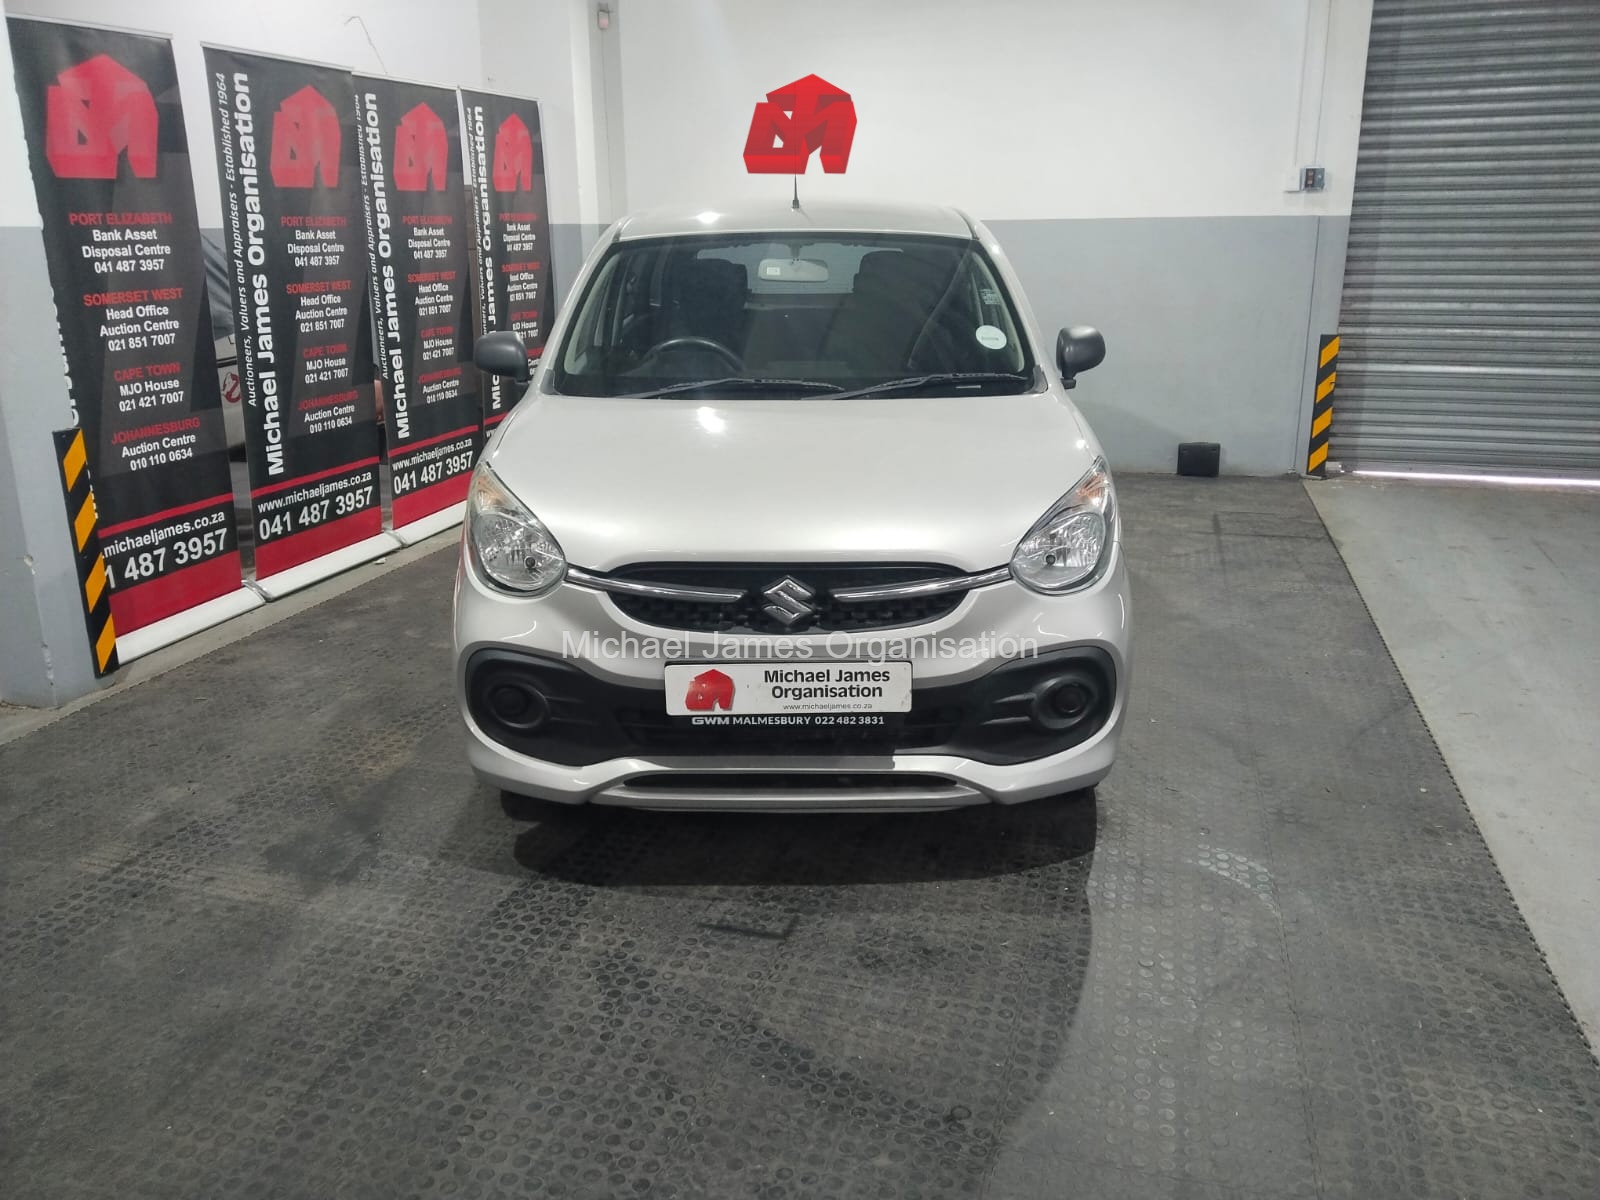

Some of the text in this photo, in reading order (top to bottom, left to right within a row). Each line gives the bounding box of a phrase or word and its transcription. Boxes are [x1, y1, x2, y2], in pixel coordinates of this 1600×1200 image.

[474, 106, 491, 251] Organisation
[69, 212, 172, 225] PORT ELIZABETH
[281, 216, 302, 226] PORT
[363, 195, 374, 250] Appraisers
[92, 228, 158, 242] Bank Asset
[216, 73, 256, 407] Auctioneers, Valuers and Appraisers Established 1964
[296, 230, 336, 240] Bank Asset
[414, 227, 444, 236] Bank Asset
[82, 244, 171, 260] Disposal Centre
[288, 242, 344, 255] Disposal Centre
[408, 239, 432, 248] Disposal
[94, 259, 164, 274] 041 487 3957
[294, 256, 340, 267] 041 487 3957
[365, 93, 410, 439] Michael James Organisation
[233, 72, 284, 476] Michael James Organisation
[286, 282, 329, 294] SOMERSET
[372, 276, 381, 314] Valuers
[432, 283, 448, 292] Office
[486, 257, 496, 325] James
[83, 288, 183, 306] SOMERSET WEST
[300, 294, 341, 306] Head Office
[414, 294, 453, 305] Auction Centre
[106, 305, 168, 320] Head Office
[296, 306, 348, 320] Auction Centre
[100, 320, 180, 337] Auction Centre
[300, 319, 344, 332] 021 851 7007
[108, 333, 176, 351] 021 851 7007
[378, 318, 388, 379] Auctioneers,
[114, 362, 181, 382] CAPE TOWN
[306, 358, 346, 370] MJO House
[305, 368, 348, 384] 021 421 7007
[120, 378, 180, 396] MJO House
[119, 391, 184, 412] 021 421 7007
[304, 404, 354, 422] Auction Centre
[112, 417, 200, 444] JOHANNESBURG
[310, 416, 352, 434] 010 110 0634
[122, 434, 196, 458] Auction Centre
[392, 438, 472, 471] www.michaeljames.co.za
[130, 448, 192, 472] 010 110 0634
[394, 451, 473, 494] 041 487 3957
[258, 472, 372, 513] www.michaeljames.co.za
[260, 486, 372, 540] 041 487 3957
[124, 547, 166, 580] 487
[173, 528, 228, 564] 3957
[764, 669, 890, 683] Michael James
[772, 684, 883, 700] Organisation
[692, 716, 884, 725] GWM MALMESBURY 022 482 3831
